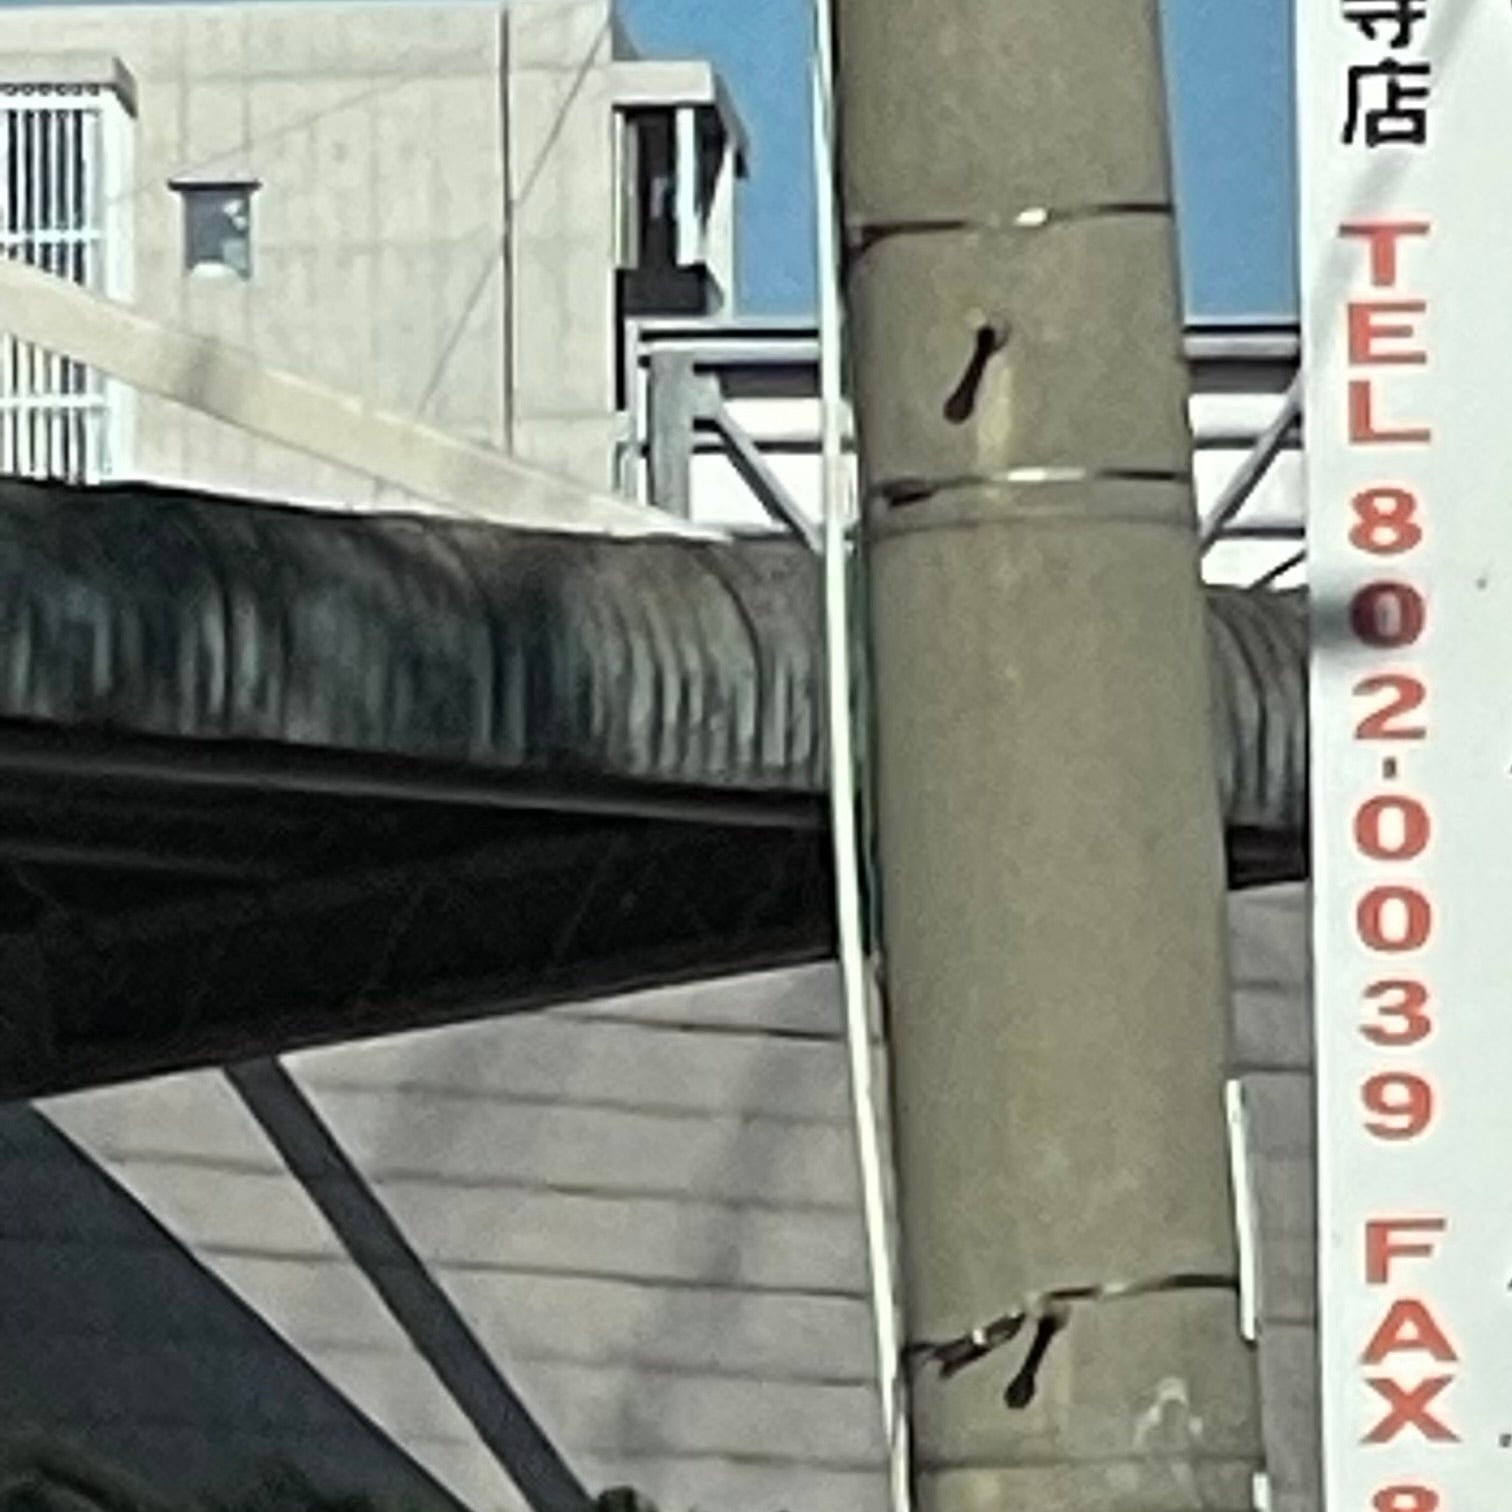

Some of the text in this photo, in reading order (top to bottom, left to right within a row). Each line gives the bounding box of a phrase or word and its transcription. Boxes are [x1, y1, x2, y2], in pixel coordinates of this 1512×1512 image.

[1340, 218, 1428, 445] TEL
[1345, 484, 1437, 1138] 802-0039
[1363, 1216, 1456, 1441] FAX
